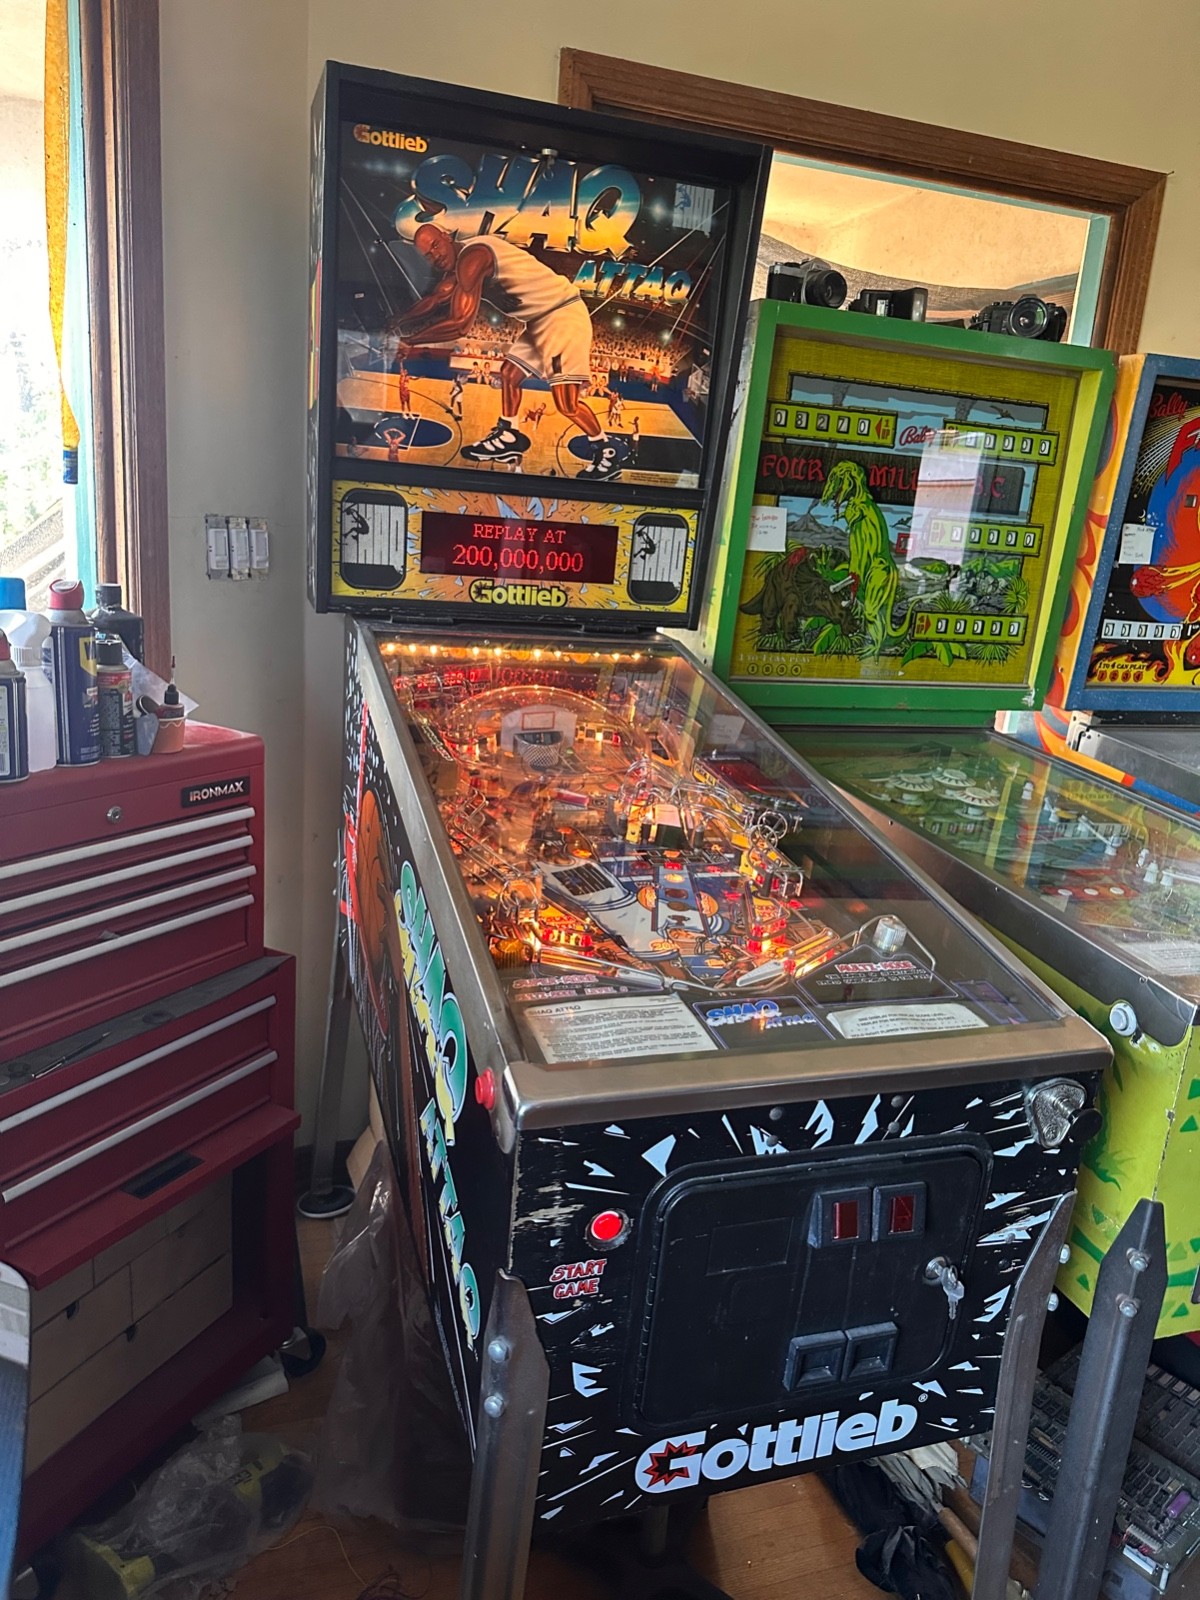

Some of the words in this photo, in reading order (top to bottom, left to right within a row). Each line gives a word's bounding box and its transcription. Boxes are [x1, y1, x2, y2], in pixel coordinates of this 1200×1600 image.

[353, 123, 428, 153] Gottlieb
[395, 153, 643, 261] SHAQ
[572, 260, 692, 307] ATTAQ
[1151, 392, 1188, 421] Bally
[762, 453, 826, 481] FOUR
[473, 523, 538, 542] REPLAY
[543, 529, 566, 544] AT
[452, 544, 584, 574] 200,000,000
[470, 579, 568, 607] Gottlieb
[189, 780, 244, 802] IRONMAX
[706, 1000, 782, 1027] SHAQ
[766, 1013, 816, 1029] ATTAQ
[549, 1258, 607, 1282] START
[553, 1278, 600, 1300] GAME
[635, 1398, 918, 1494] Gottlieb
